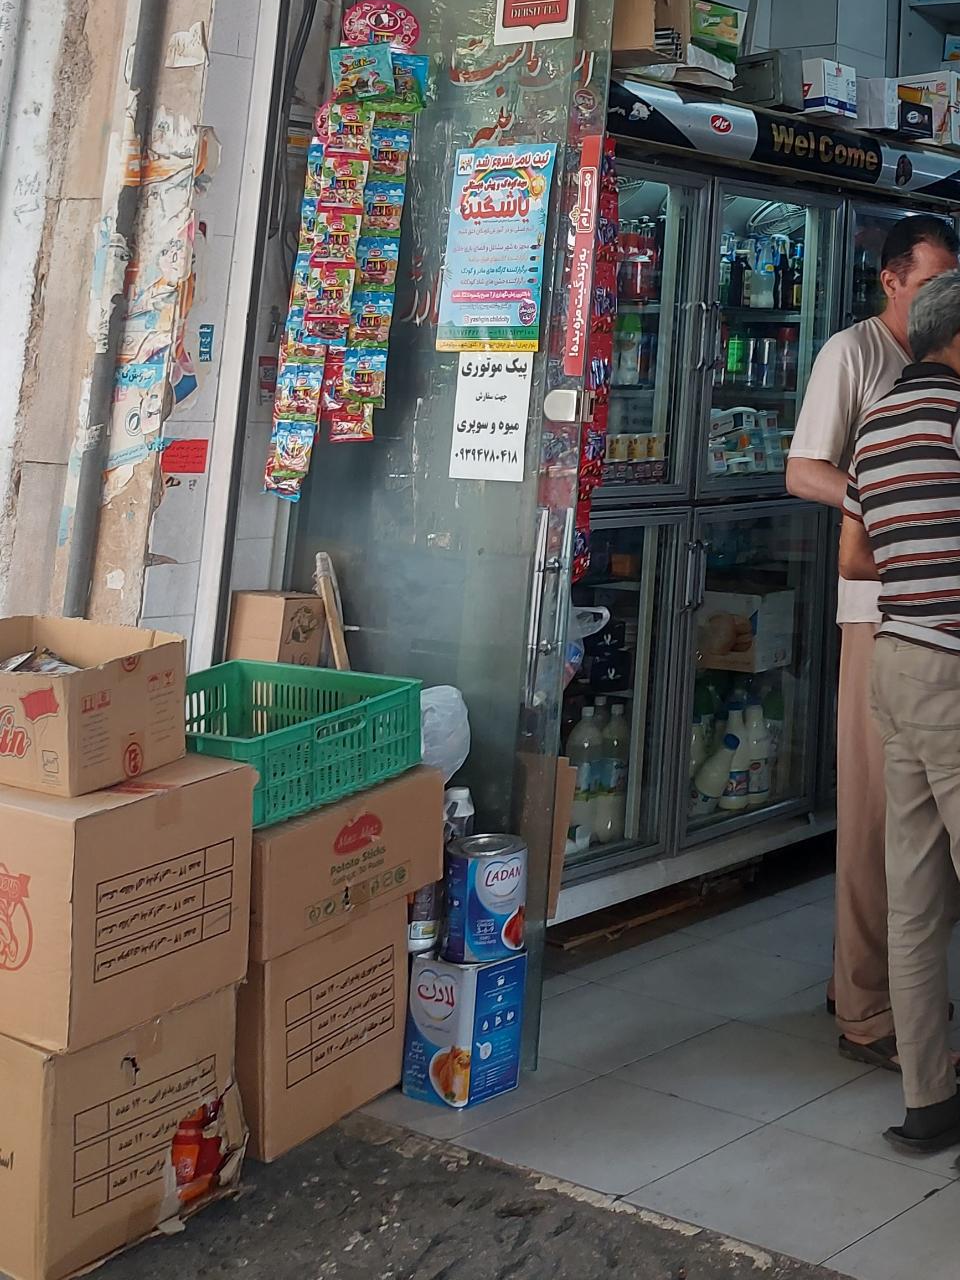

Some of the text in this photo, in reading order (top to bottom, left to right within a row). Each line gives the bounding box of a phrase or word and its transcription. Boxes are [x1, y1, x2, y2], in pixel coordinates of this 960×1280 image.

[581, 172, 591, 227] مهرام
[461, 357, 528, 379] پیک موتوری
[475, 392, 508, 403] جهت سفارش
[456, 420, 520, 435] میوه و سوپری
[485, 865, 522, 888] LADAN
[417, 983, 455, 1007] لادن
